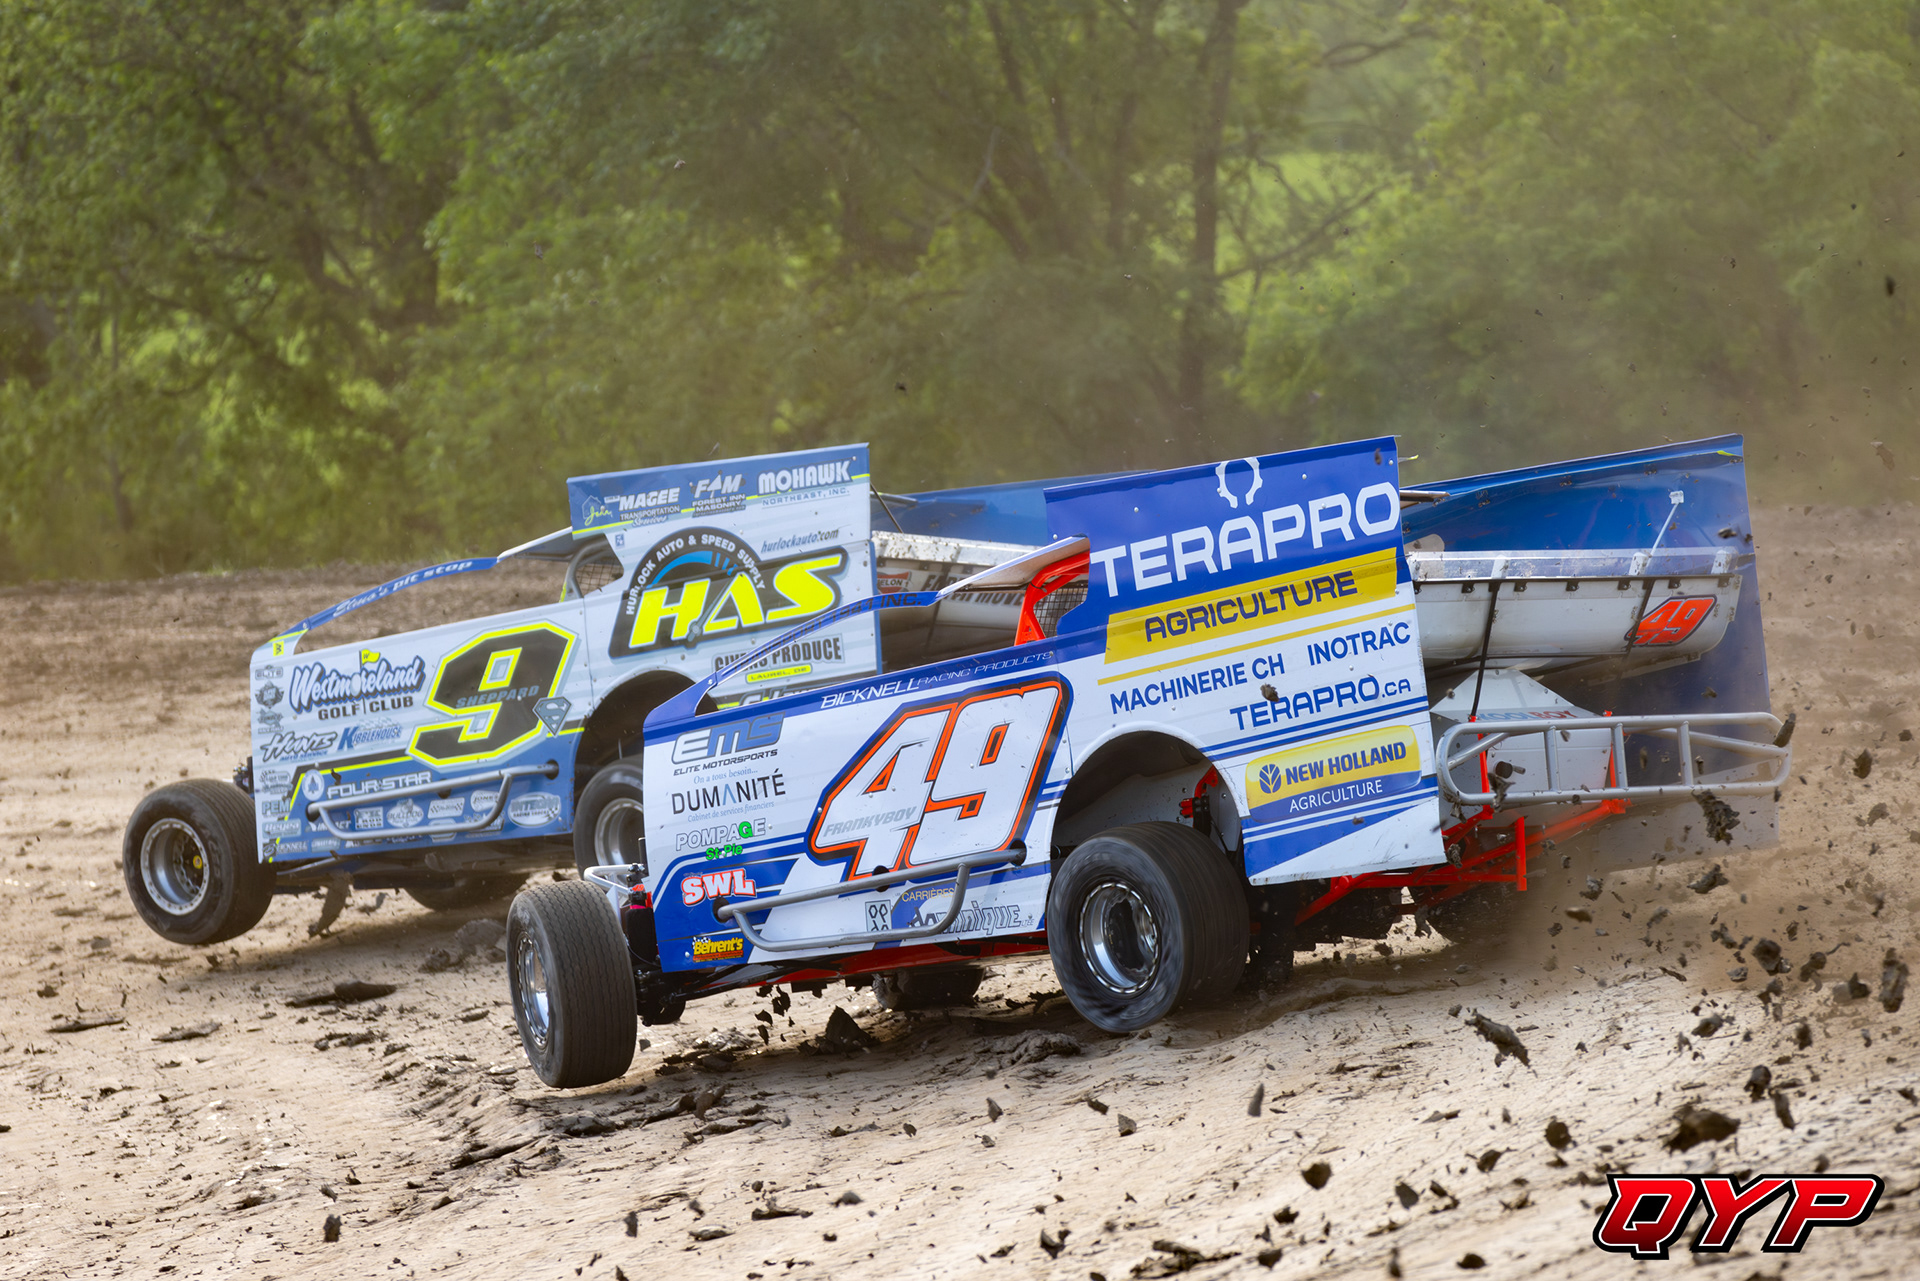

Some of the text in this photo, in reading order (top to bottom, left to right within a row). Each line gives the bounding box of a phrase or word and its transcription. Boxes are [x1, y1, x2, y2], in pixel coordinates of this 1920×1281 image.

[758, 460, 852, 494] MOHAWK
[619, 487, 681, 511] MAGEE
[695, 500, 742, 513] MASONRY
[762, 486, 851, 507] NORTHEAST, INC.
[619, 505, 681, 521] TRANSPORTATION
[760, 528, 839, 554] hurlockauto.com
[1090, 482, 1401, 598] TERAPRO
[422, 560, 474, 579] stop
[655, 537, 685, 562] AUTO
[688, 534, 697, 546] &
[701, 534, 736, 553] SPEED
[736, 549, 766, 590] SUPPLY
[628, 552, 844, 649] HAS
[879, 591, 922, 607] INC.
[1145, 570, 1358, 642] AGRICULTURE
[1624, 594, 1717, 647] 49
[772, 637, 842, 665] PRODUCE
[1306, 621, 1411, 666] INOTRAC
[290, 655, 426, 714] Westmoreland
[407, 620, 578, 768] 9
[820, 677, 920, 709] BICKNELL
[916, 668, 971, 685] RACING
[973, 651, 1053, 675] PRODUCTS
[1110, 653, 1286, 714] MACHINERIE CH
[317, 695, 414, 721] GOLF CLUB
[455, 685, 541, 708] SHEPPARD
[673, 748, 779, 776] ELITE MOTORSPORTS
[1286, 742, 1407, 786] NEW HOLLAND
[326, 770, 434, 800] FOUR STAR
[693, 776, 706, 785] On
[811, 680, 1064, 883] 49
[262, 799, 290, 815] PEM
[687, 799, 775, 823] Cabinet de services financiers
[1289, 779, 1383, 814] AGRICULTURE
[675, 817, 767, 851] POMPAGE
[823, 805, 918, 838] FRANKYBOY
[681, 868, 757, 907] SWL
[901, 886, 955, 903] CARRIÈRES
[693, 937, 744, 955] Behrent's
